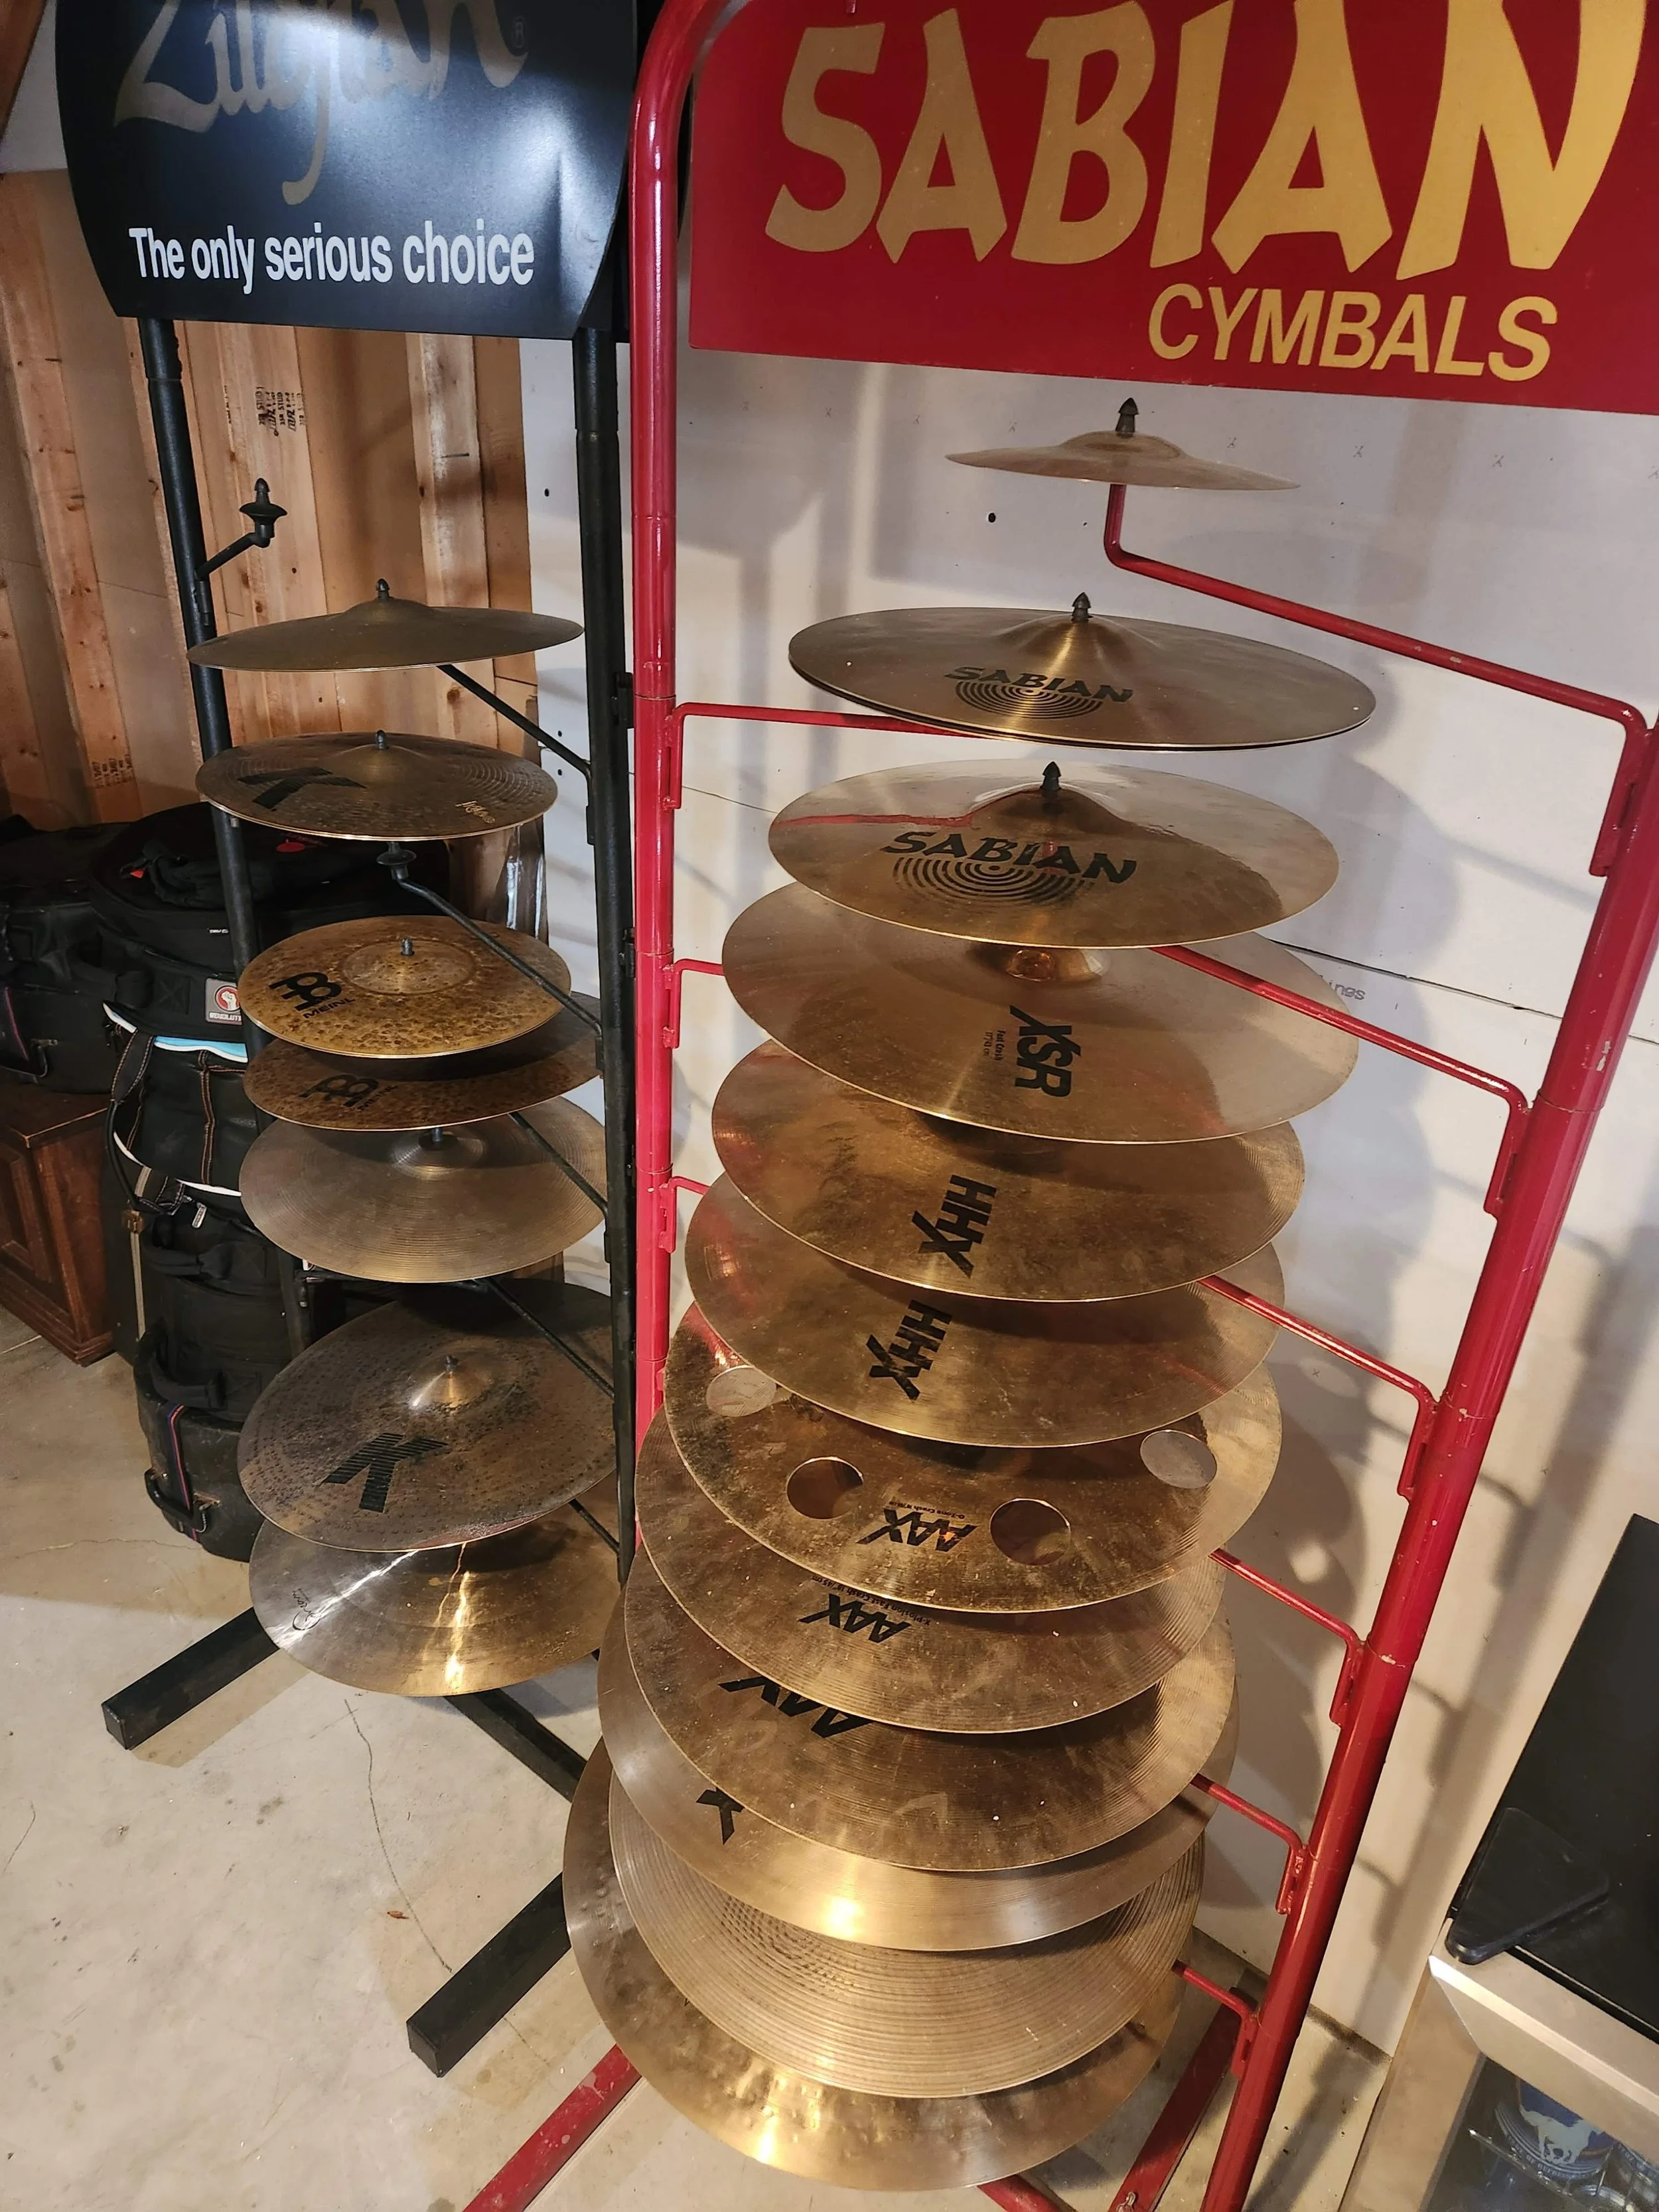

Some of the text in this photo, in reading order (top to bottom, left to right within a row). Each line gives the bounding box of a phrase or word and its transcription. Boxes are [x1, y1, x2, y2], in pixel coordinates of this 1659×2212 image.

[766, 0, 1644, 280] SABIAN
[129, 218, 534, 295] The only serious choice
[1148, 282, 1558, 383] CYMBALS
[945, 666, 1133, 703] SABIAN
[237, 767, 366, 809] K
[880, 831, 1137, 884] SABIAN
[303, 997, 356, 1019] MEINL
[1009, 1005, 1082, 1099] XSR
[356, 1085, 399, 1111] MEINL
[912, 1174, 997, 1278] HHX
[868, 1299, 954, 1402] HHX
[321, 1432, 450, 1513] K
[857, 1509, 977, 1554] AAX
[800, 1593, 912, 1644] AAX
[846, 1587, 871, 1602] Crash
[871, 1597, 891, 1609] Fast
